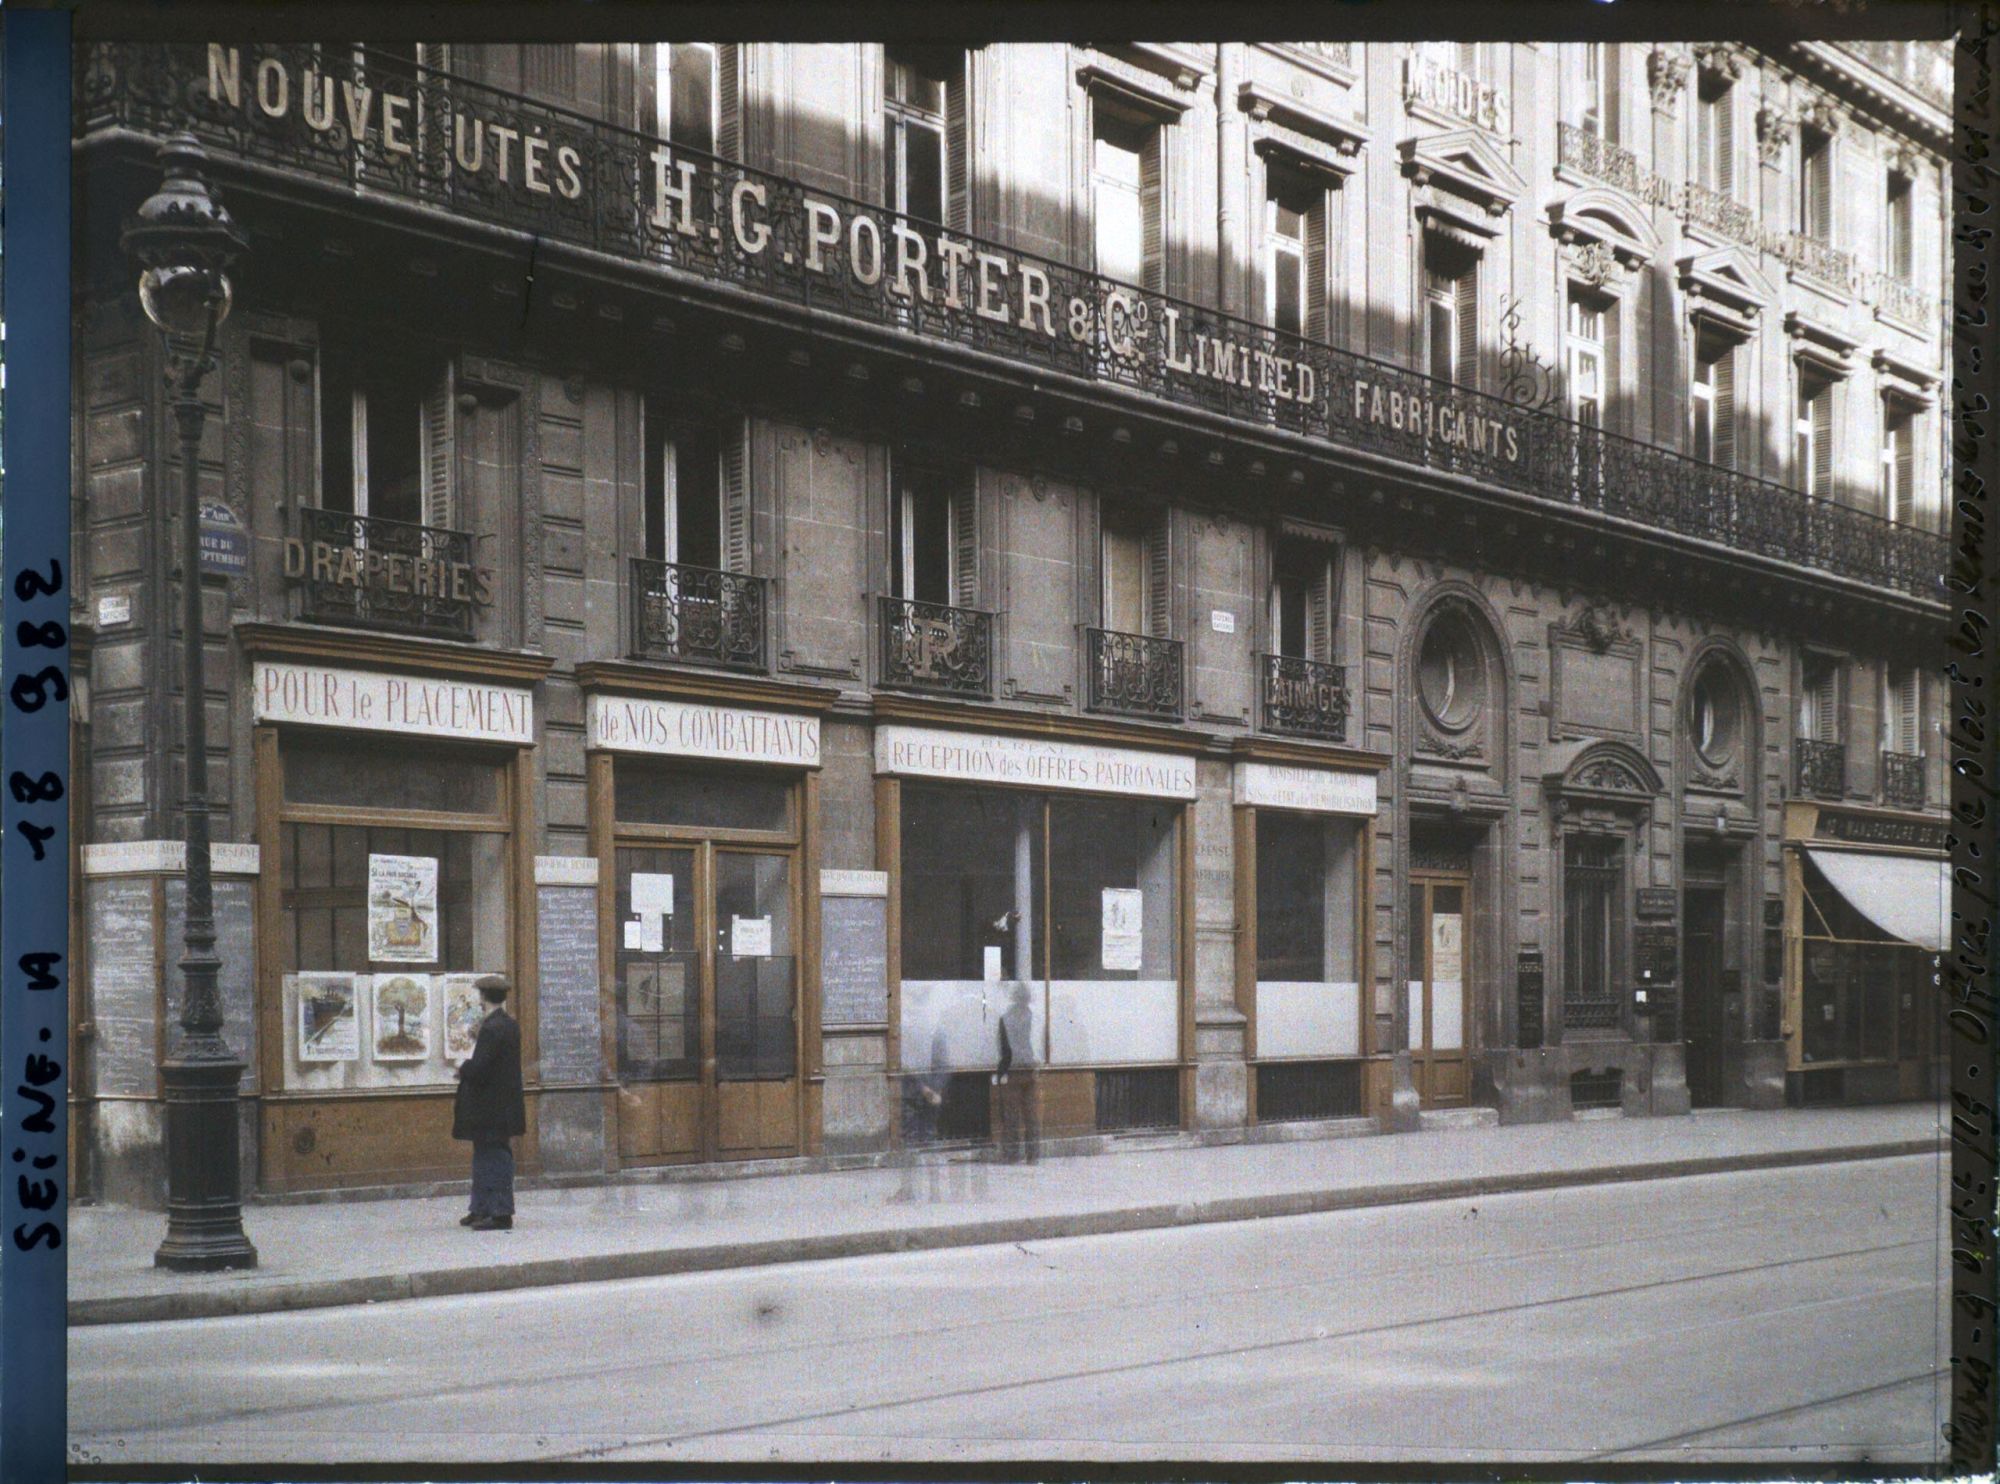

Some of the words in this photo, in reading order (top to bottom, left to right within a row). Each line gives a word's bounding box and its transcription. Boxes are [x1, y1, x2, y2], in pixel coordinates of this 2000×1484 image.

[206, 42, 582, 200] NOUVEUTÉS
[1067, 297, 1093, 342] &
[1163, 307, 1315, 404] LIMITED
[1354, 380, 1519, 462] FABRICANTS
[283, 537, 494, 605] DRAPERIES
[263, 665, 340, 719] POUR
[351, 679, 373, 721] le
[386, 678, 532, 737] PLACEMENT
[599, 712, 620, 745] de
[624, 701, 669, 747] NOS
[678, 707, 820, 760] COMBATTANTS
[893, 740, 996, 775] RECEPTION
[999, 753, 1022, 778] des
[1026, 754, 1090, 784] OFFRES
[1095, 760, 1194, 794] PATRONALES
